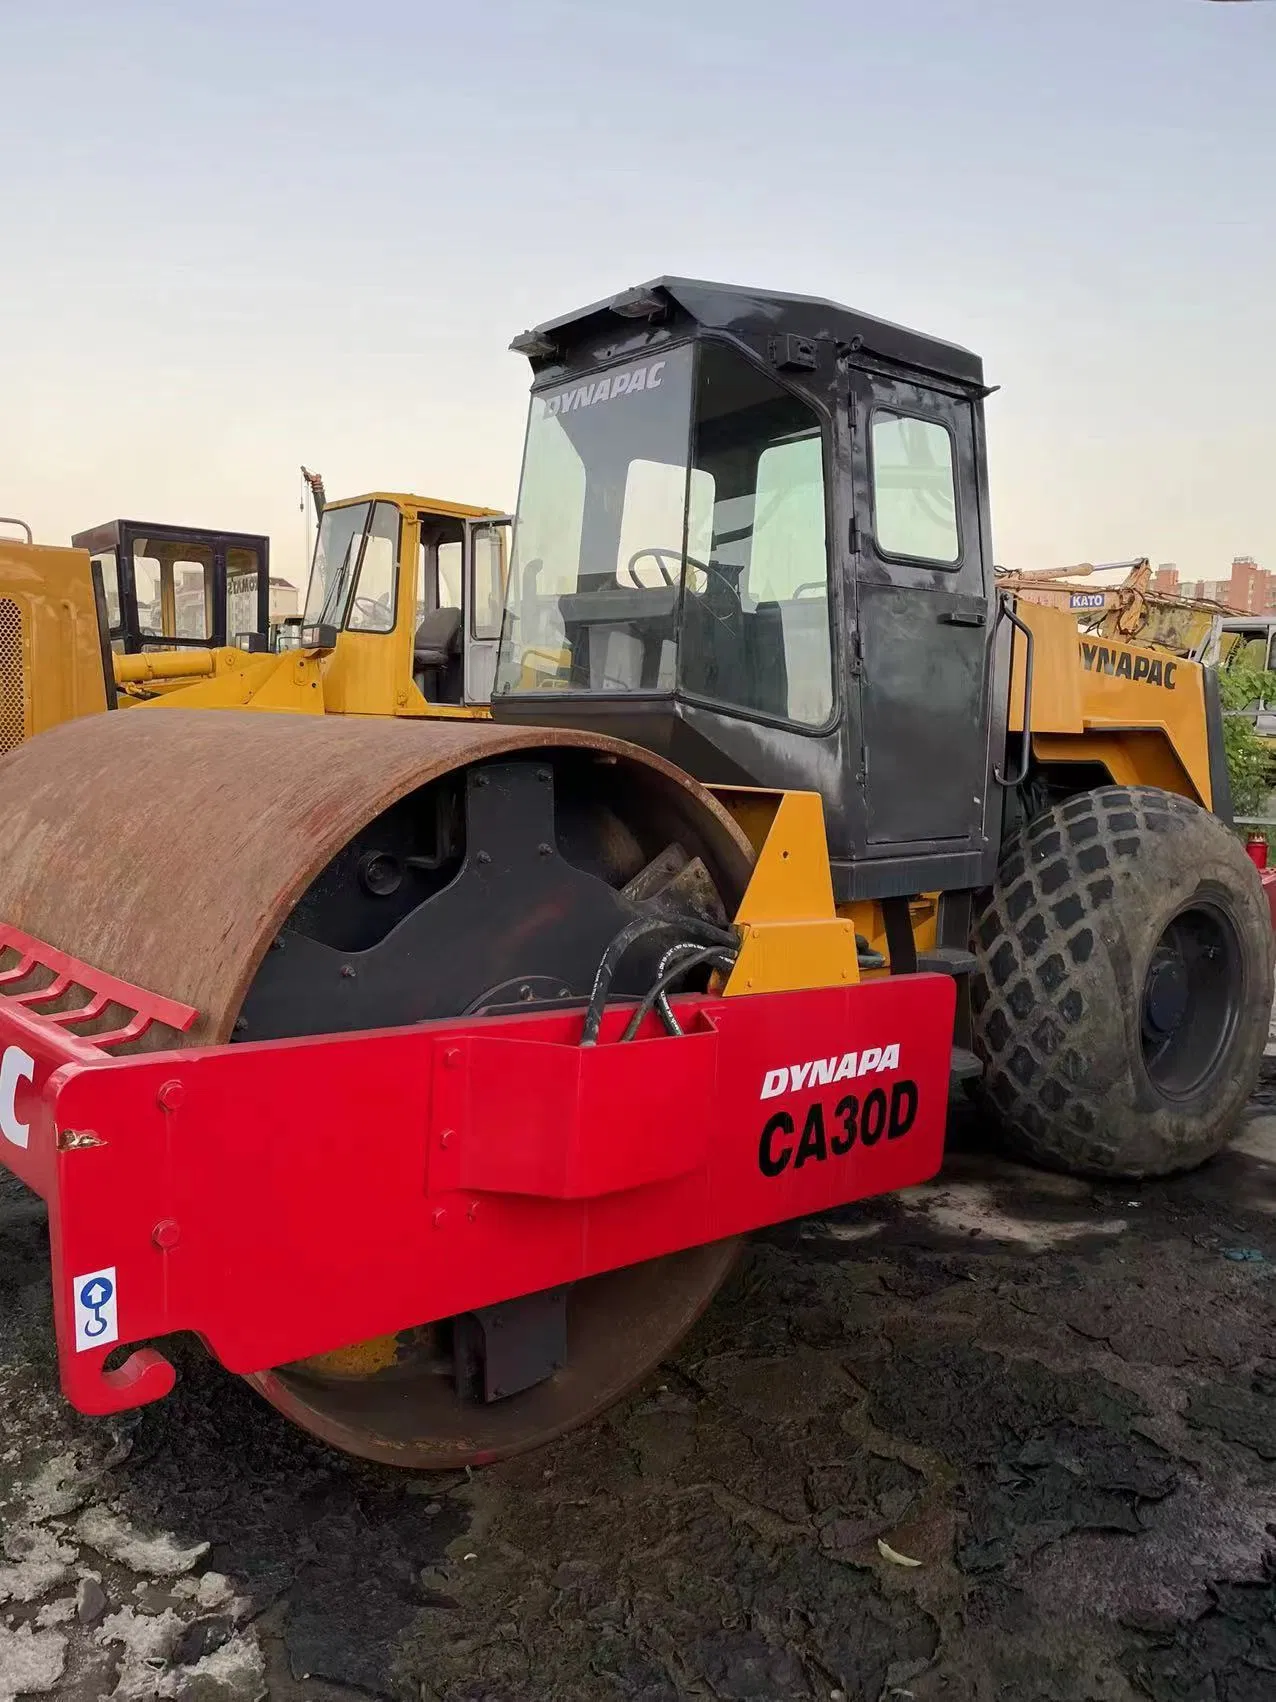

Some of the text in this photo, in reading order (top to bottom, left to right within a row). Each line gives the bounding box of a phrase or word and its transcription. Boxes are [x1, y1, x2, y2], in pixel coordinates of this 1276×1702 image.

[543, 361, 666, 420] DYNAPAC
[1072, 594, 1103, 607] KATO
[1079, 641, 1178, 690] YNAPAC
[760, 1043, 901, 1100] DYNAPA
[758, 1079, 919, 1178] CA30D
